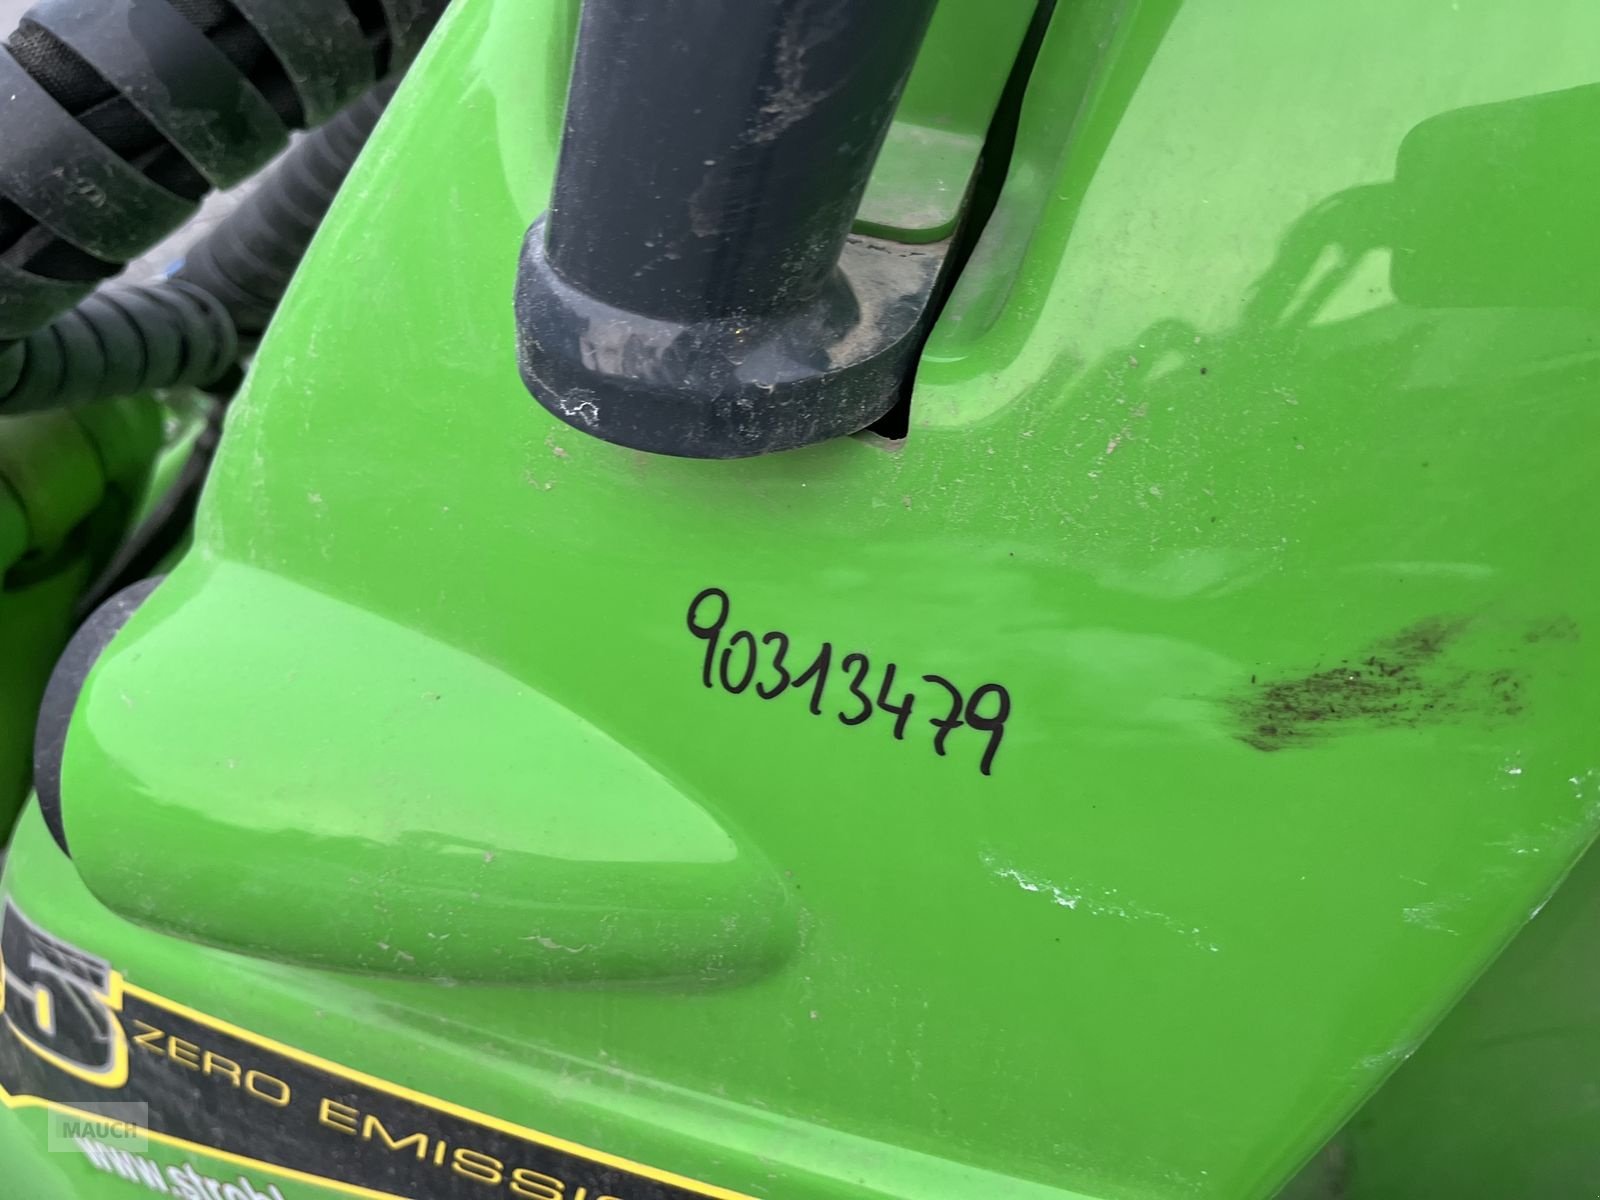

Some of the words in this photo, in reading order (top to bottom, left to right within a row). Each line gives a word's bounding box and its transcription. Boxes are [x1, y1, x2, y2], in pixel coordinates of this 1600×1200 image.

[687, 587, 1011, 776] 90313479
[130, 1018, 292, 1108] ZERO
[318, 1096, 624, 1200] EMISSI
